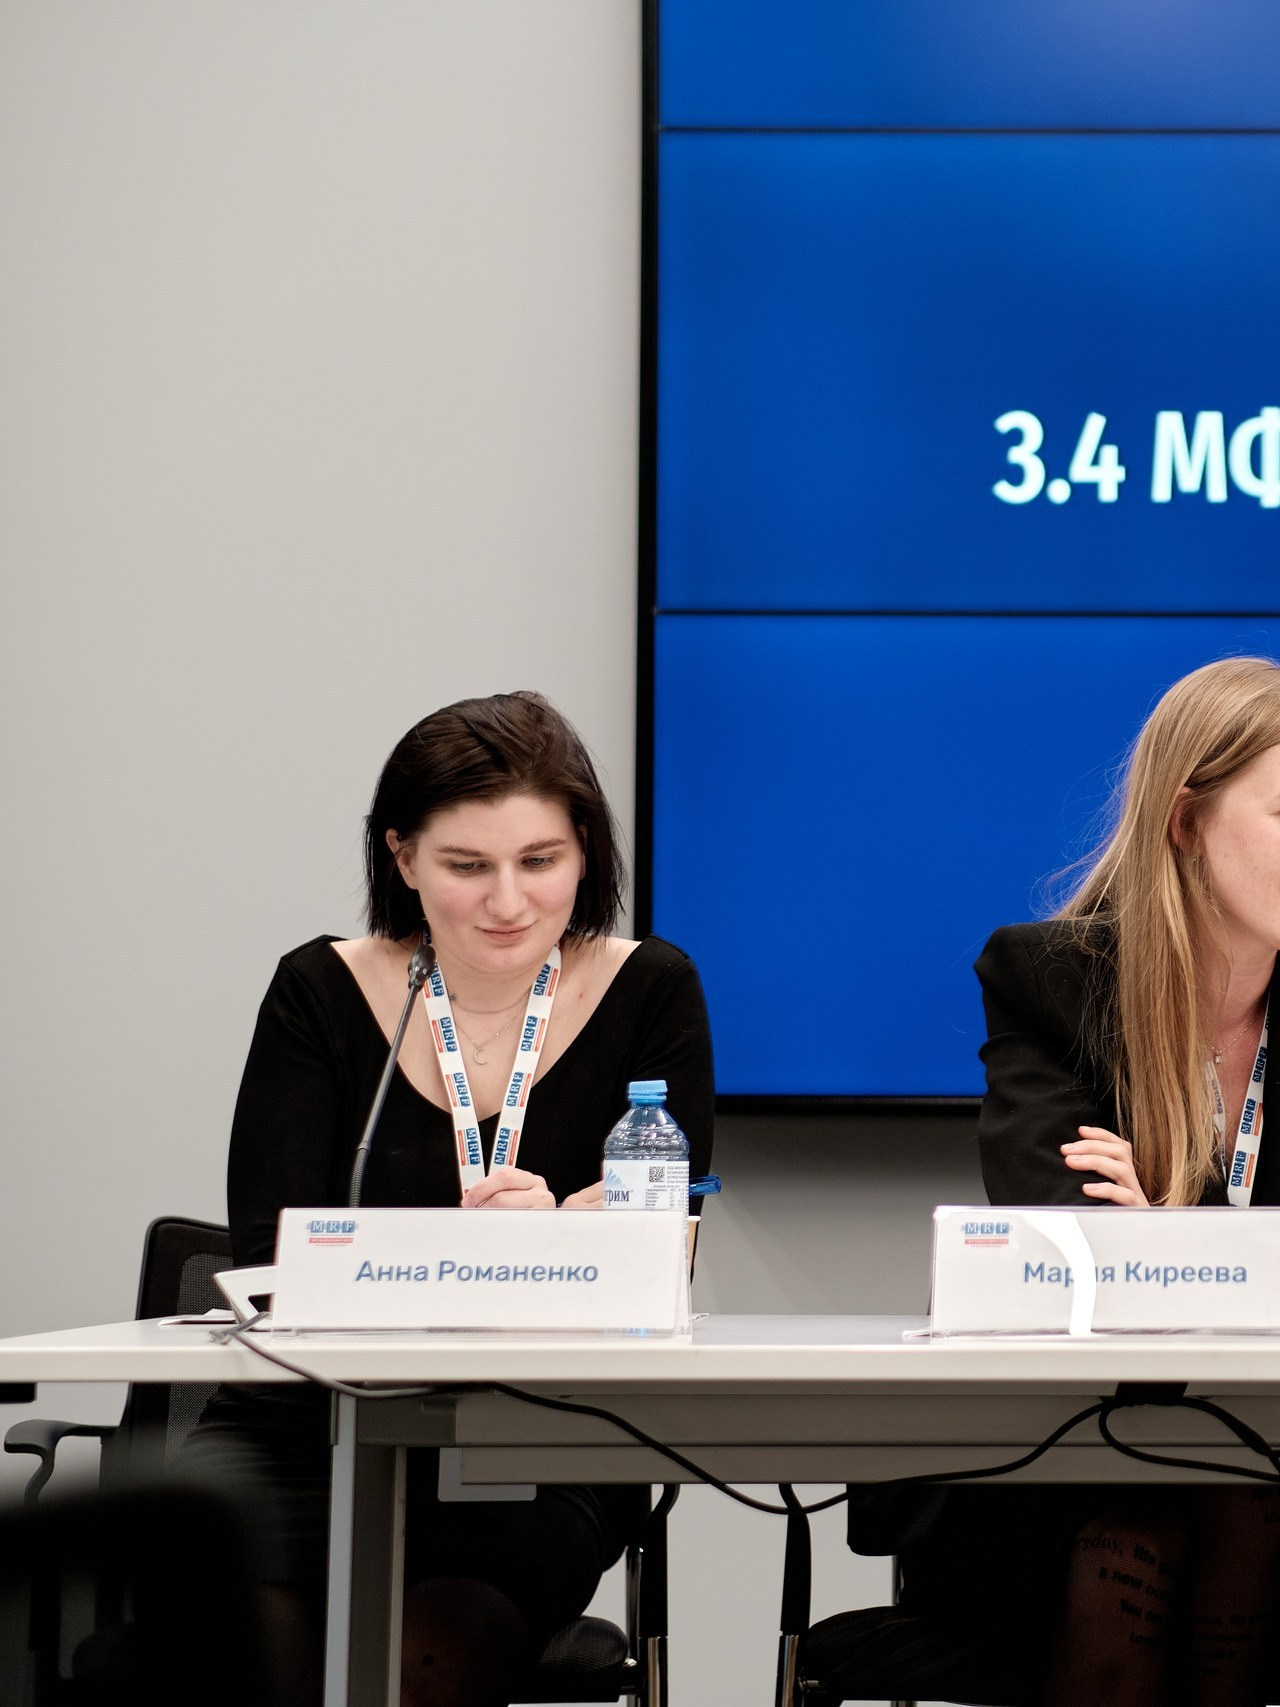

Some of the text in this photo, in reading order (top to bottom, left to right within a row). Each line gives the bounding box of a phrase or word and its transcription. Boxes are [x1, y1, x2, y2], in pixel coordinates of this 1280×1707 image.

[992, 410, 1127, 505] 3.4
[534, 962, 551, 997] MRF
[440, 1016, 458, 1052] MRF
[521, 1015, 538, 1051] MRF
[453, 1071, 470, 1107] MRF
[506, 1071, 524, 1107] MRF
[1241, 1098, 1256, 1134] MRF
[466, 1127, 481, 1165] MRF
[494, 1126, 511, 1165] MRF
[1231, 1150, 1246, 1187] MRF
[311, 1220, 355, 1232] MRF
[966, 1222, 1009, 1234] MRF
[355, 1260, 599, 1282] Анна Романенко
[1024, 1261, 1248, 1288] Маря Киреева
